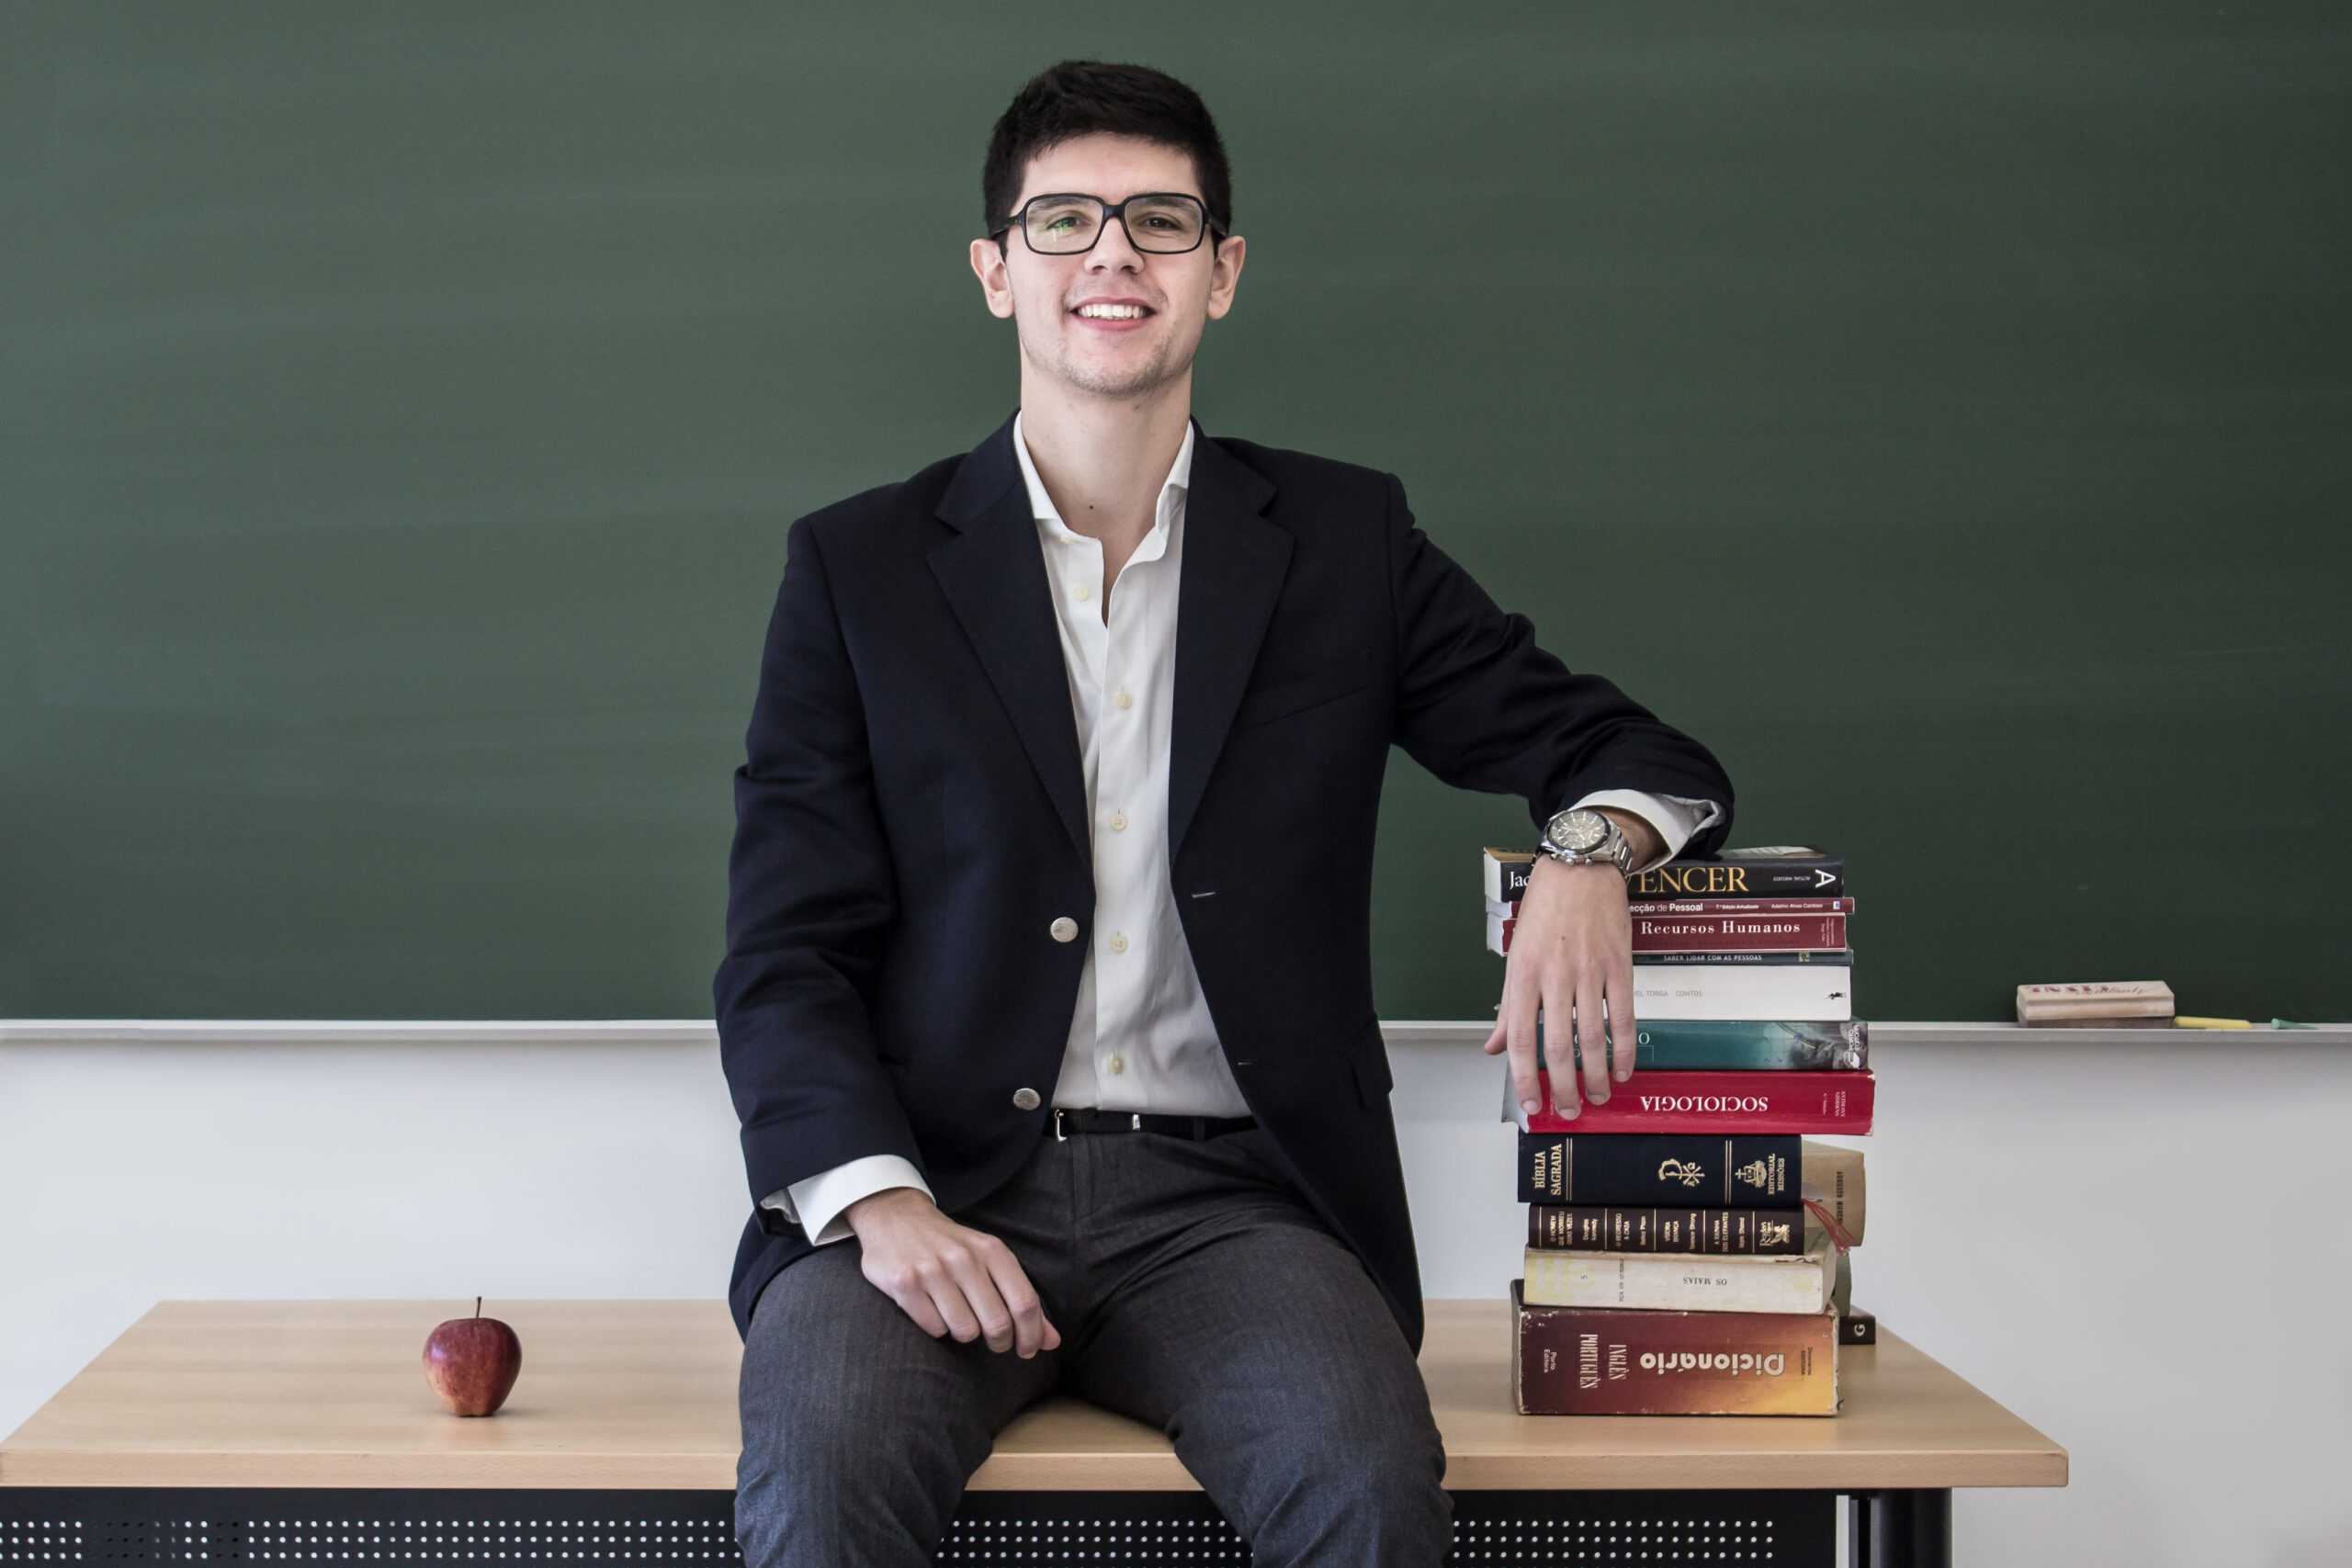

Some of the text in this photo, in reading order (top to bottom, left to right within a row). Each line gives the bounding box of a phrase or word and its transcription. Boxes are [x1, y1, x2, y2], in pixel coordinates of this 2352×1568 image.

[1626, 866, 1750, 894] ENCER
[1657, 904, 1668, 912] de
[1669, 903, 1703, 912] Pessoal
[1641, 920, 1801, 935] Recursos Humanos
[1640, 1096, 1769, 1111] SOCIOLOGIA
[1532, 1150, 1545, 1189] BÍBLIA
[1551, 1143, 1562, 1196] SAGRADA
[1777, 1157, 1785, 1191] MISSÕES
[1689, 1213, 1697, 1230] Strong
[1683, 1277, 1727, 1285] OS MAIAS
[1854, 1324, 1865, 1337] G
[1640, 1352, 1785, 1376] Dicionário
